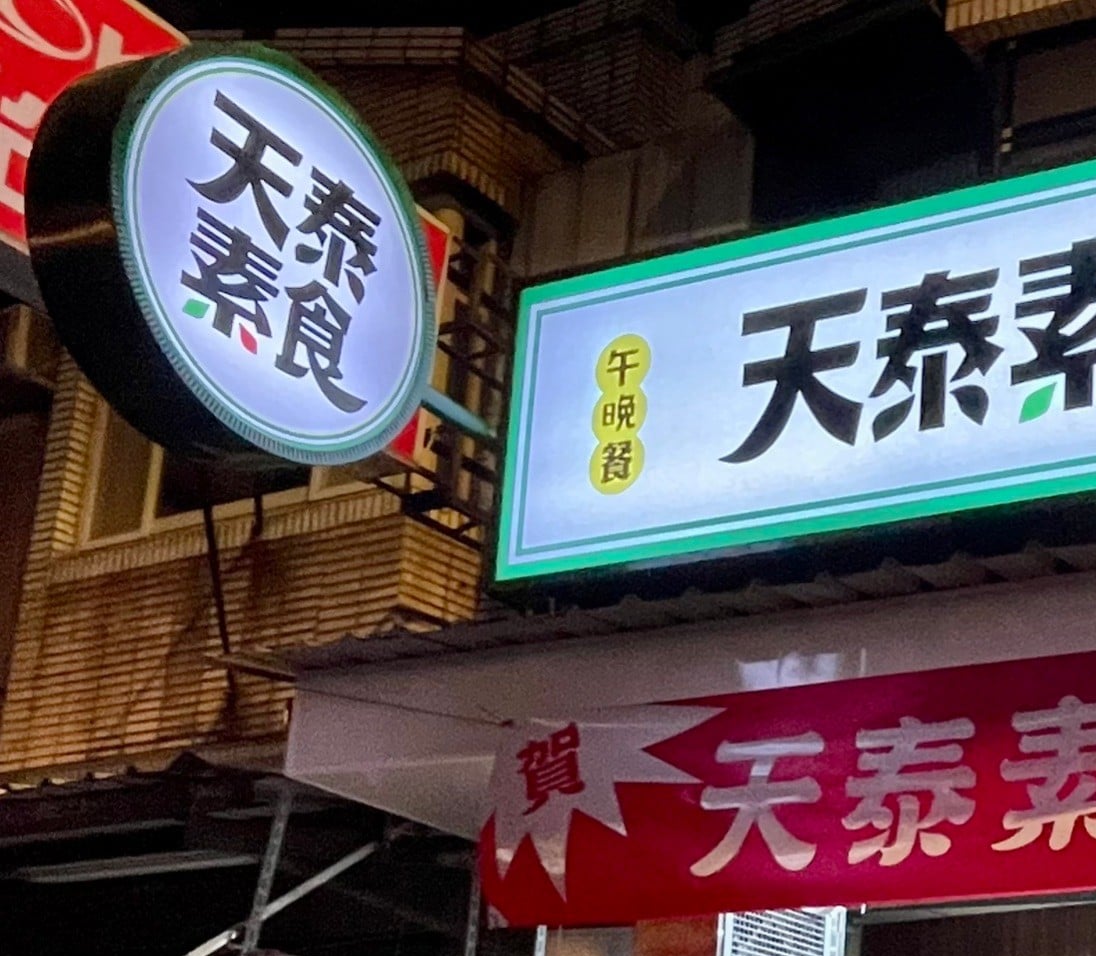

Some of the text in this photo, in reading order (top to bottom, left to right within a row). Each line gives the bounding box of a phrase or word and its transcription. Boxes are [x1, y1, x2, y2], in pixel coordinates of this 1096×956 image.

[185, 89, 383, 304] 天泰
[180, 206, 369, 414] 素食
[600, 348, 641, 484] 午晚餐
[516, 721, 586, 816] 賀
